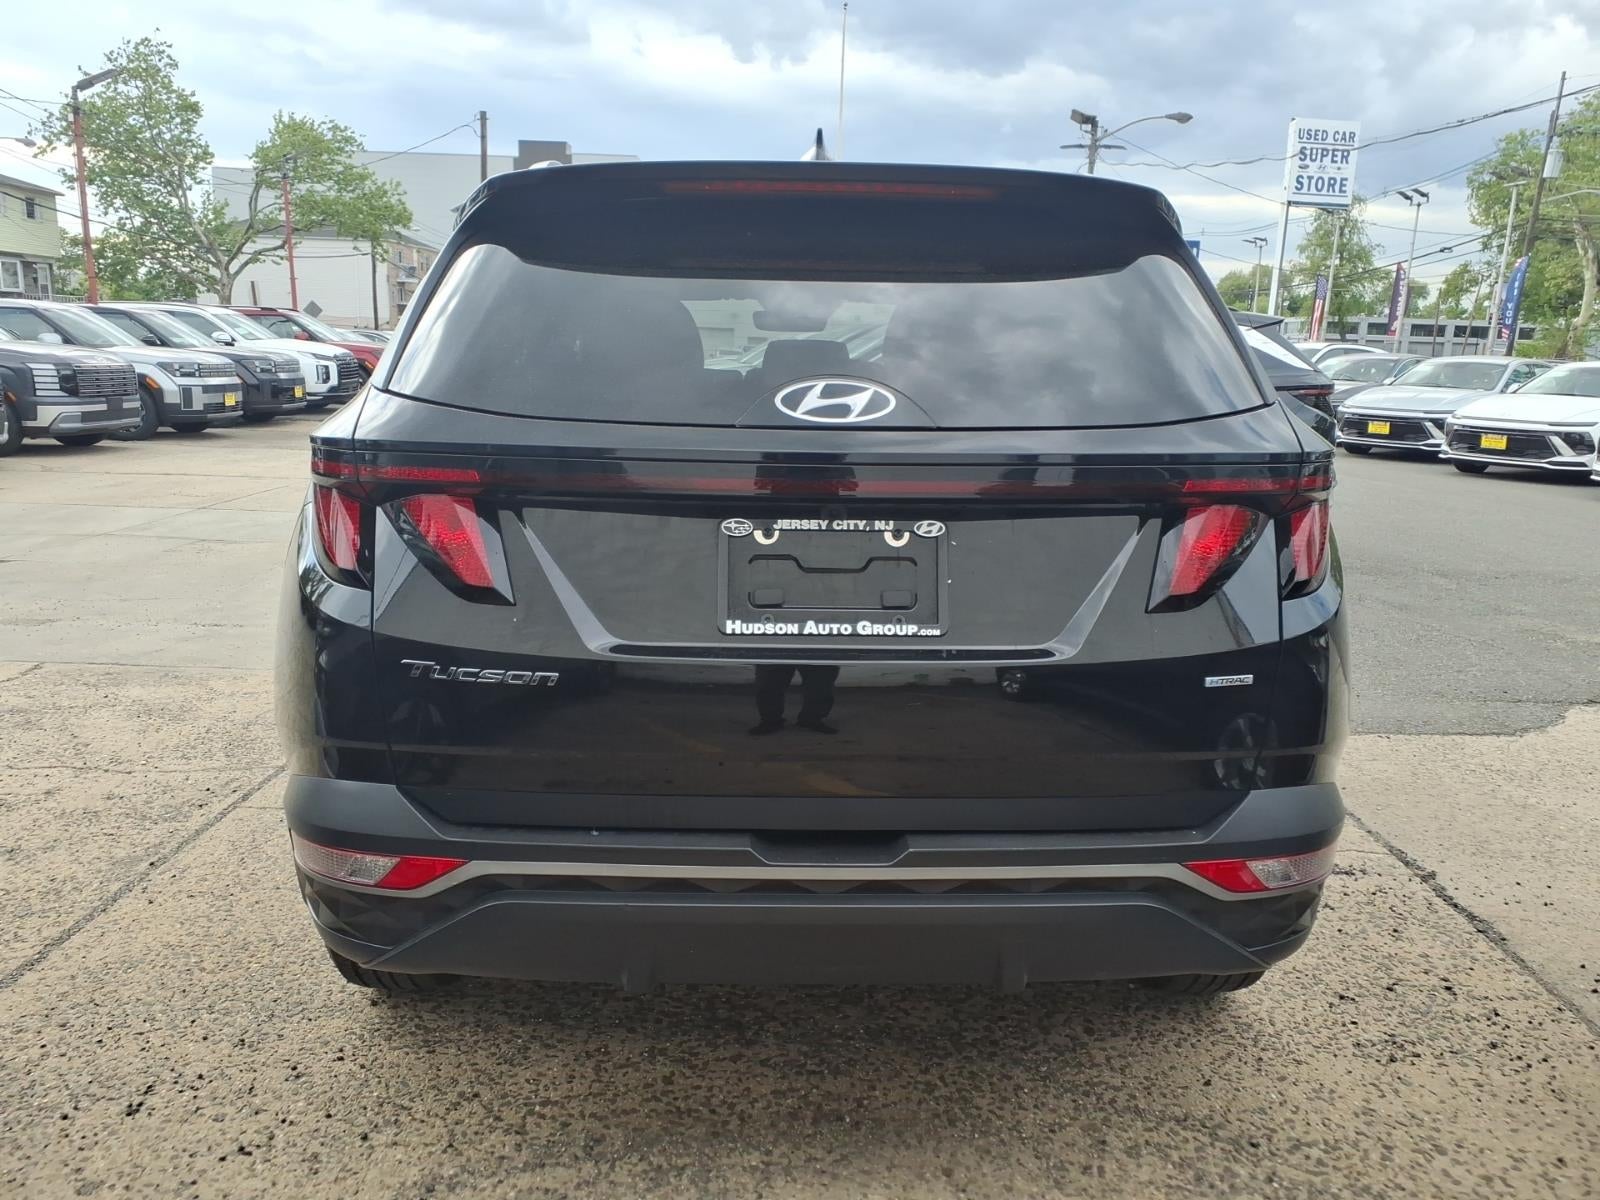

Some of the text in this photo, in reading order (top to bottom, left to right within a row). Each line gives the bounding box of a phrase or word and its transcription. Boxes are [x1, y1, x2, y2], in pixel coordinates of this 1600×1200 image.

[1298, 128, 1356, 143] USED CAR
[1298, 146, 1351, 164] SUPER
[1294, 174, 1349, 194] STORE
[773, 519, 895, 531] JERSEY CITY, NJ
[725, 619, 799, 635] HUDSON
[803, 620, 853, 636] AUTO
[1208, 676, 1251, 686] HTRAC
